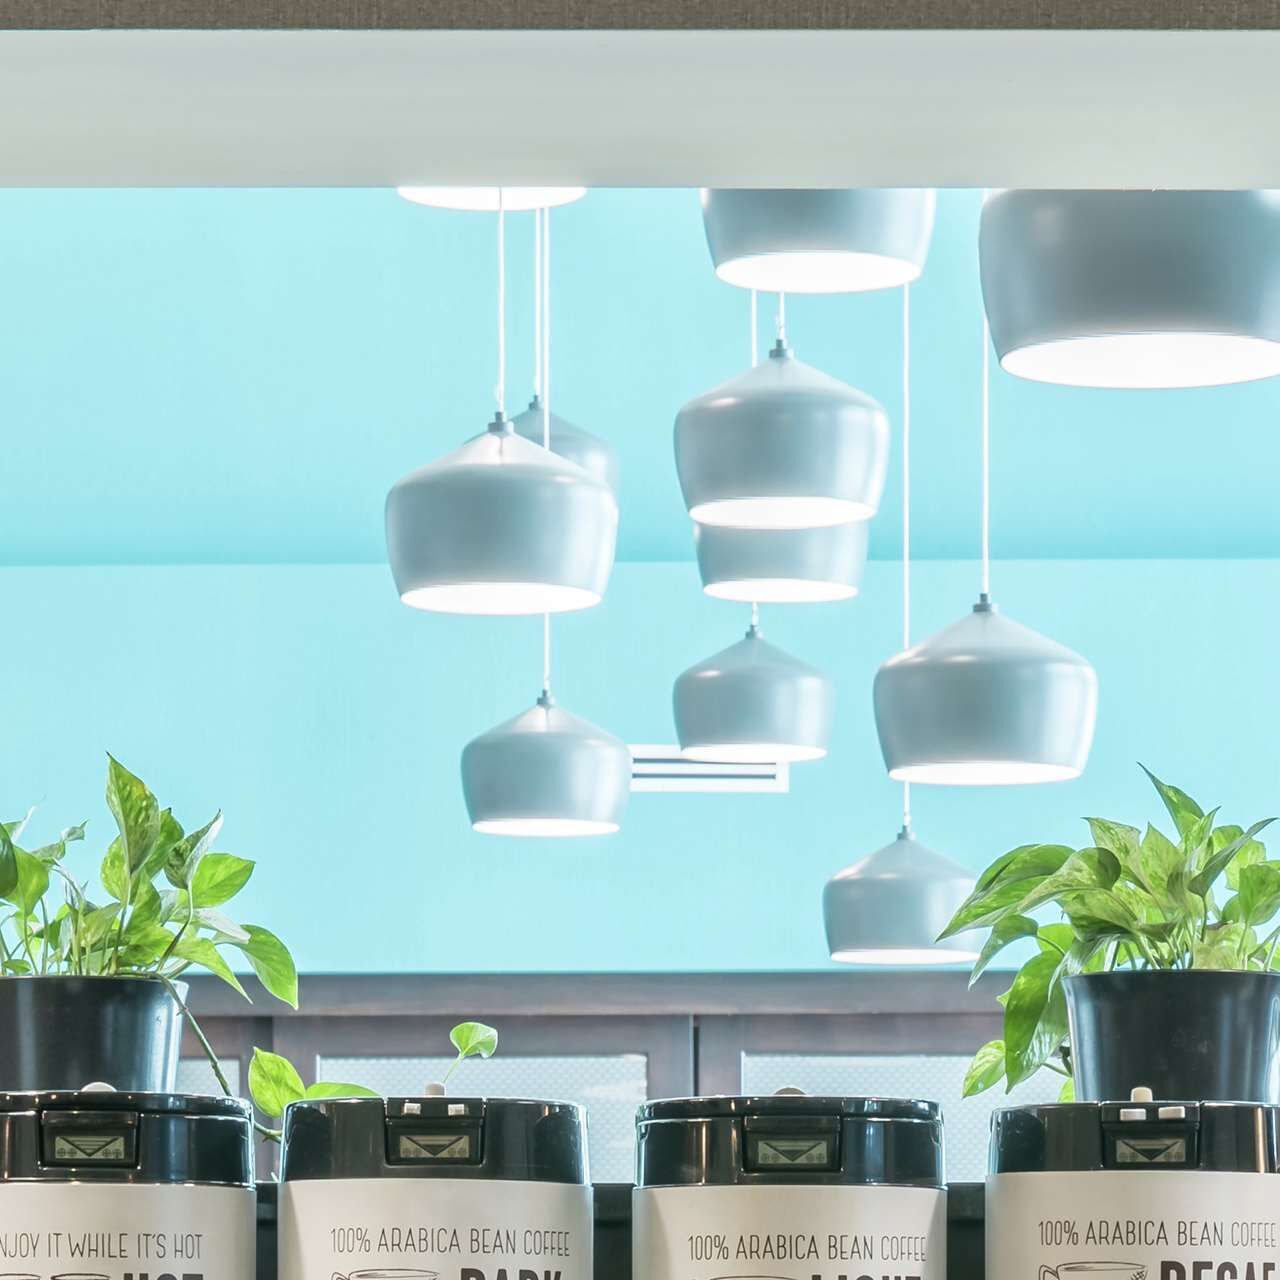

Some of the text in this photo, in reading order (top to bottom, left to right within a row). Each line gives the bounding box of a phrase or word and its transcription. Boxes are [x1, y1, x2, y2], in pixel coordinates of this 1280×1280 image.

[48, 1233, 63, 1258] IT
[68, 1233, 129, 1258] WHILE
[137, 1233, 166, 1259] IT'S
[174, 1234, 203, 1260] HOT
[331, 1228, 570, 1256] 100% ARABICA BEAN COFFEE
[1038, 1220, 1277, 1248] 100% ARABICA BEAN COFFEE
[688, 1235, 927, 1262] 100% ARABICA BEAN COFFEE
